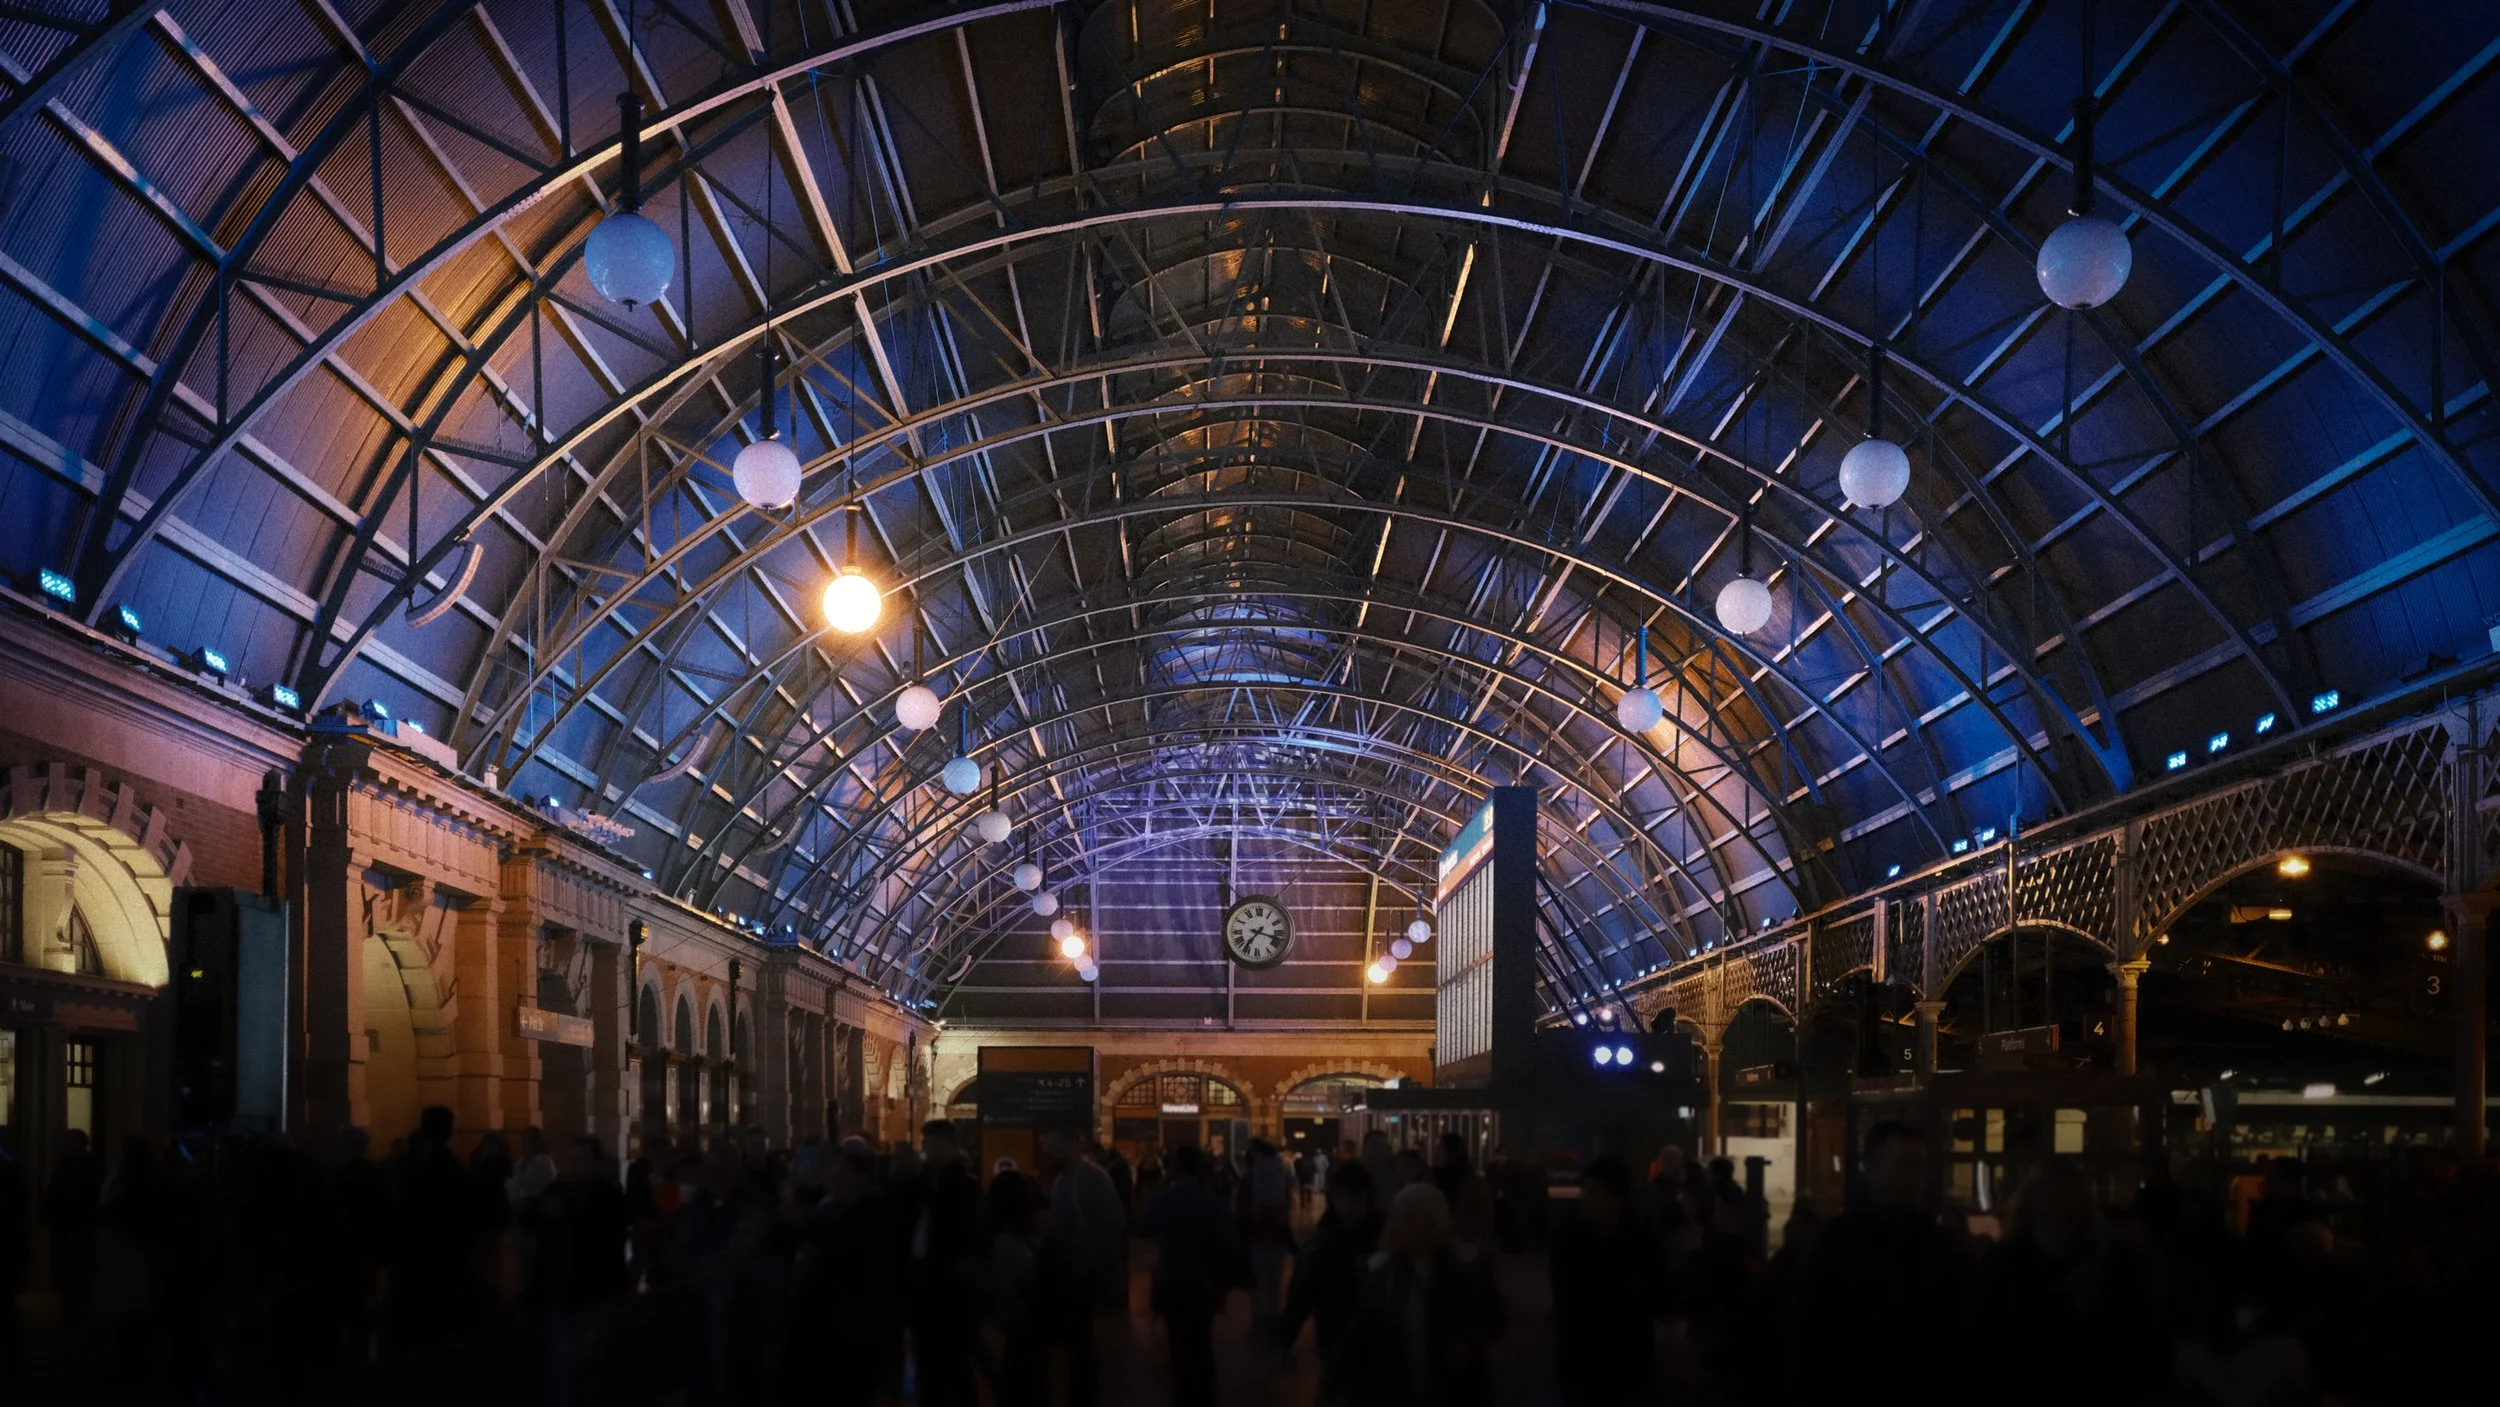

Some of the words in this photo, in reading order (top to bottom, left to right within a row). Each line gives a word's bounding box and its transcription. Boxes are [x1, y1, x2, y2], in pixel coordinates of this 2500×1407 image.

[2426, 975, 2441, 996] 3
[2093, 1021, 2105, 1036] 4
[1903, 1048, 1913, 1060] 5
